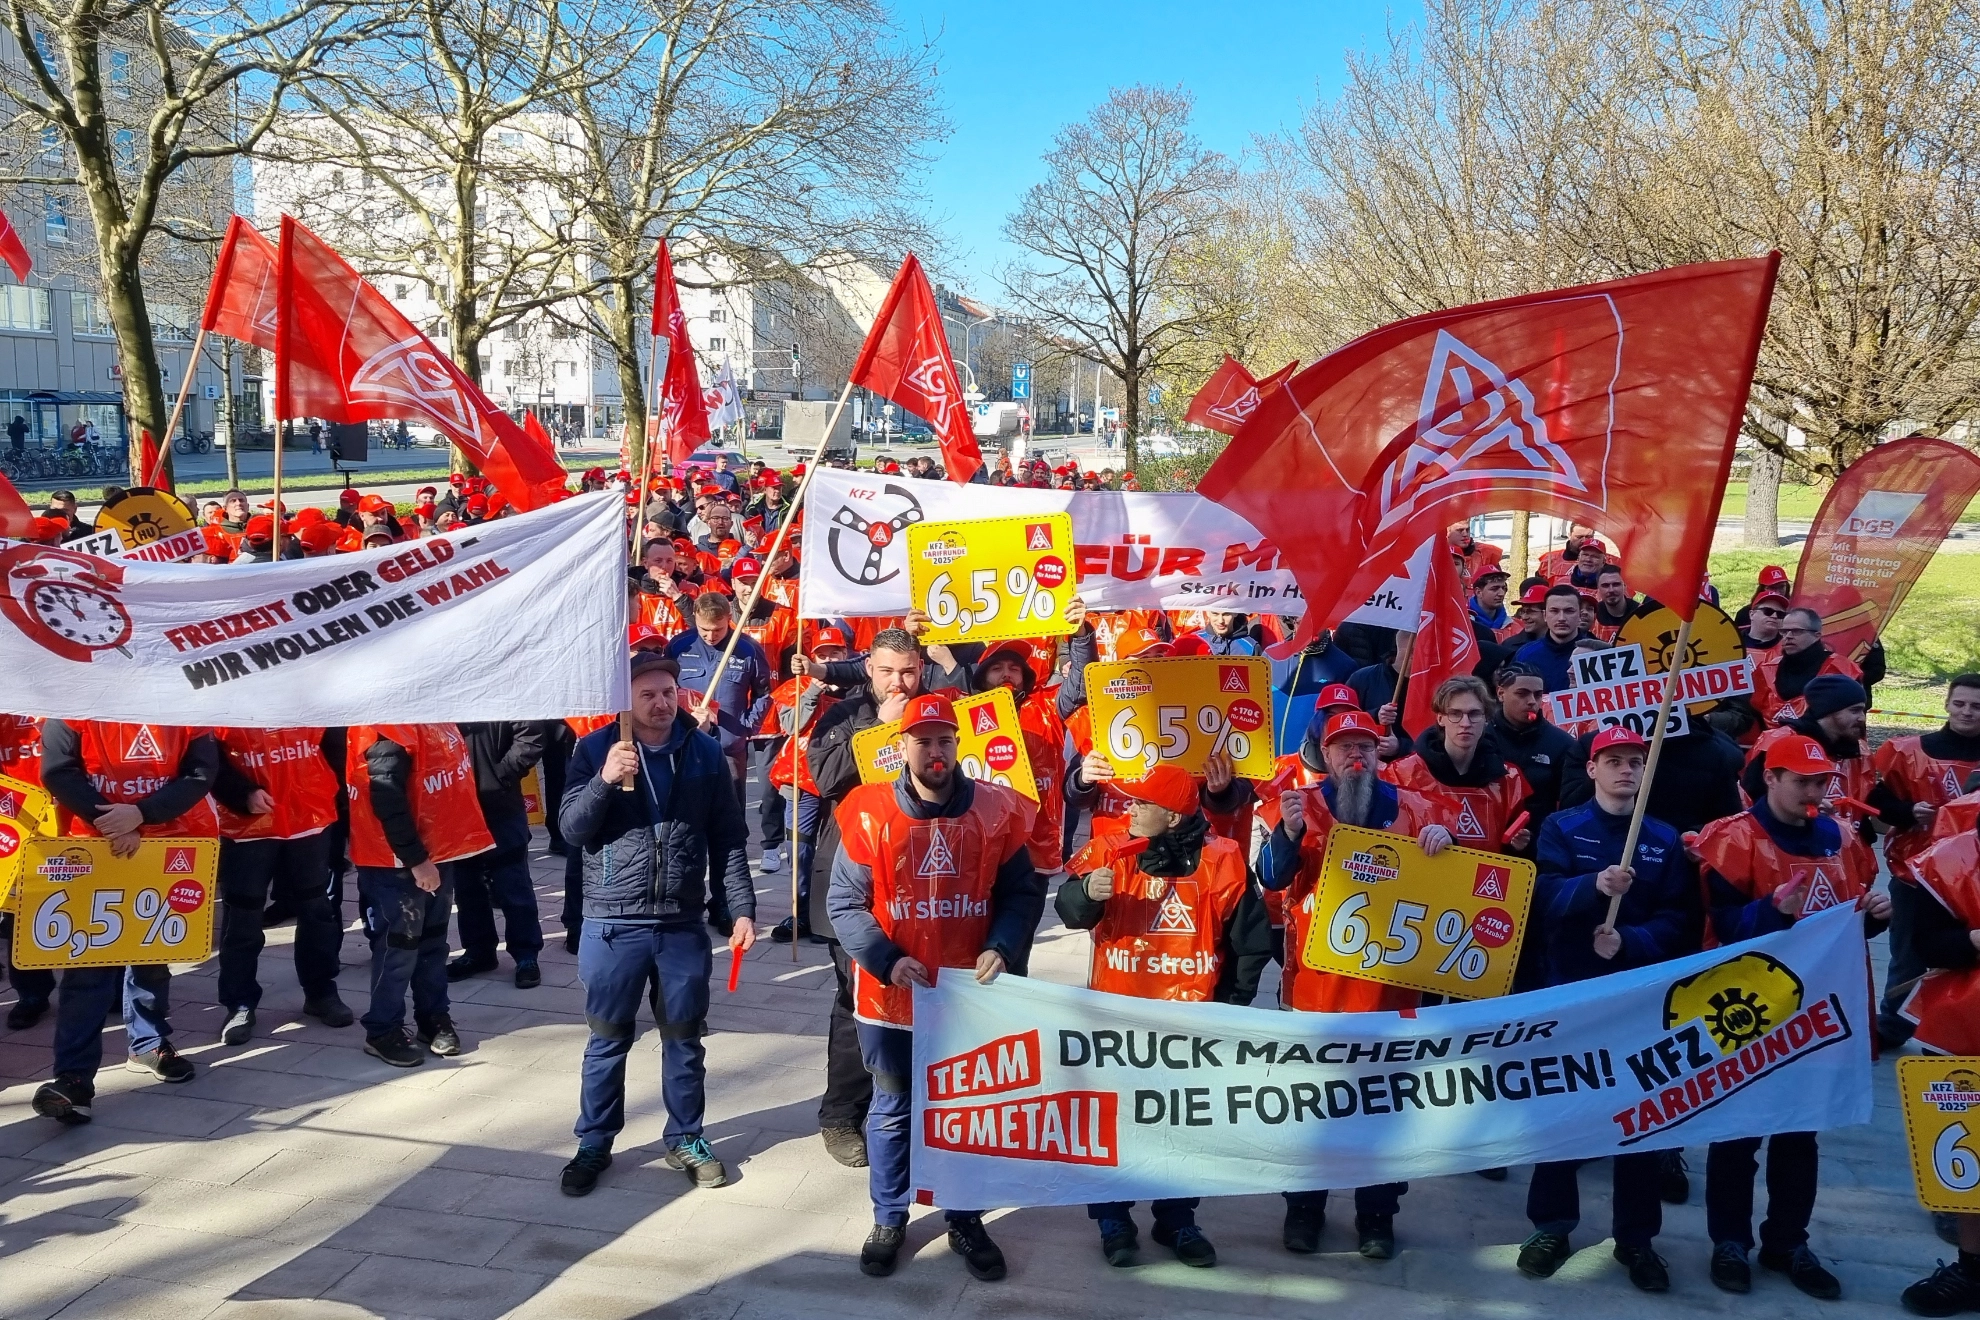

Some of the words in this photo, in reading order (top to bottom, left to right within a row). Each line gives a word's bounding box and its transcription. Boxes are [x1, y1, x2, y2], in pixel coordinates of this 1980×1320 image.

[849, 487, 877, 502] KFZ
[1849, 517, 1895, 534] DGB
[923, 548, 967, 558] TARIFRUNDE
[929, 541, 944, 551] KFZ
[1831, 542, 1851, 552] Mit
[933, 556, 952, 565] 2025
[1074, 533, 1206, 585] FÜR
[1829, 551, 1901, 570] Tarifvertrag
[1826, 563, 1842, 574] ist
[1842, 565, 1874, 577] mehr
[1876, 568, 1895, 579] für
[1824, 573, 1850, 585] dich
[1851, 576, 1880, 589] drin.
[163, 598, 293, 653] FREIZEIT
[291, 569, 381, 616] ODER
[376, 537, 455, 584] GELD
[1179, 581, 1240, 597] Stark
[1248, 580, 1276, 599] im
[181, 652, 251, 690] WIR
[243, 614, 371, 671] WOLLEN
[364, 592, 424, 629] DIE
[415, 558, 512, 608] WAHL
[1578, 650, 1639, 685] KFZ
[1104, 685, 1152, 694] TARIFRUNDE
[1110, 679, 1127, 687] KFZ
[1114, 692, 1137, 700] 2025
[1555, 663, 1750, 720] TARIFRUNDE
[878, 746, 892, 758] KFZ
[885, 760, 904, 773] 2025
[423, 770, 453, 795] Wir
[47, 857, 64, 866] KFZ
[1353, 852, 1373, 865] KFZ
[38, 865, 92, 874] TARIFRUNDE
[48, 873, 72, 882] 2025
[1343, 860, 1398, 880] TARIFRUNDE
[1352, 871, 1377, 884] 2025
[1475, 922, 1486, 932] für
[1484, 926, 1505, 941] Azubis
[1106, 947, 1139, 974] Wir
[1058, 1029, 1223, 1070] DRUCK
[1235, 1037, 1452, 1066] MACHEN
[1460, 1020, 1560, 1056] FÜR
[932, 1038, 1030, 1096] TEAM
[1626, 1025, 1714, 1094] KFZ
[1612, 998, 1841, 1139] TARIFRUNDE
[1134, 1087, 1213, 1128] DIE
[1226, 1053, 1616, 1126] FORDERUNGEN!
[1931, 1082, 1953, 1093] KFZ
[1923, 1092, 1980, 1103] TARIFRUND
[1938, 1101, 1968, 1112] 2025
